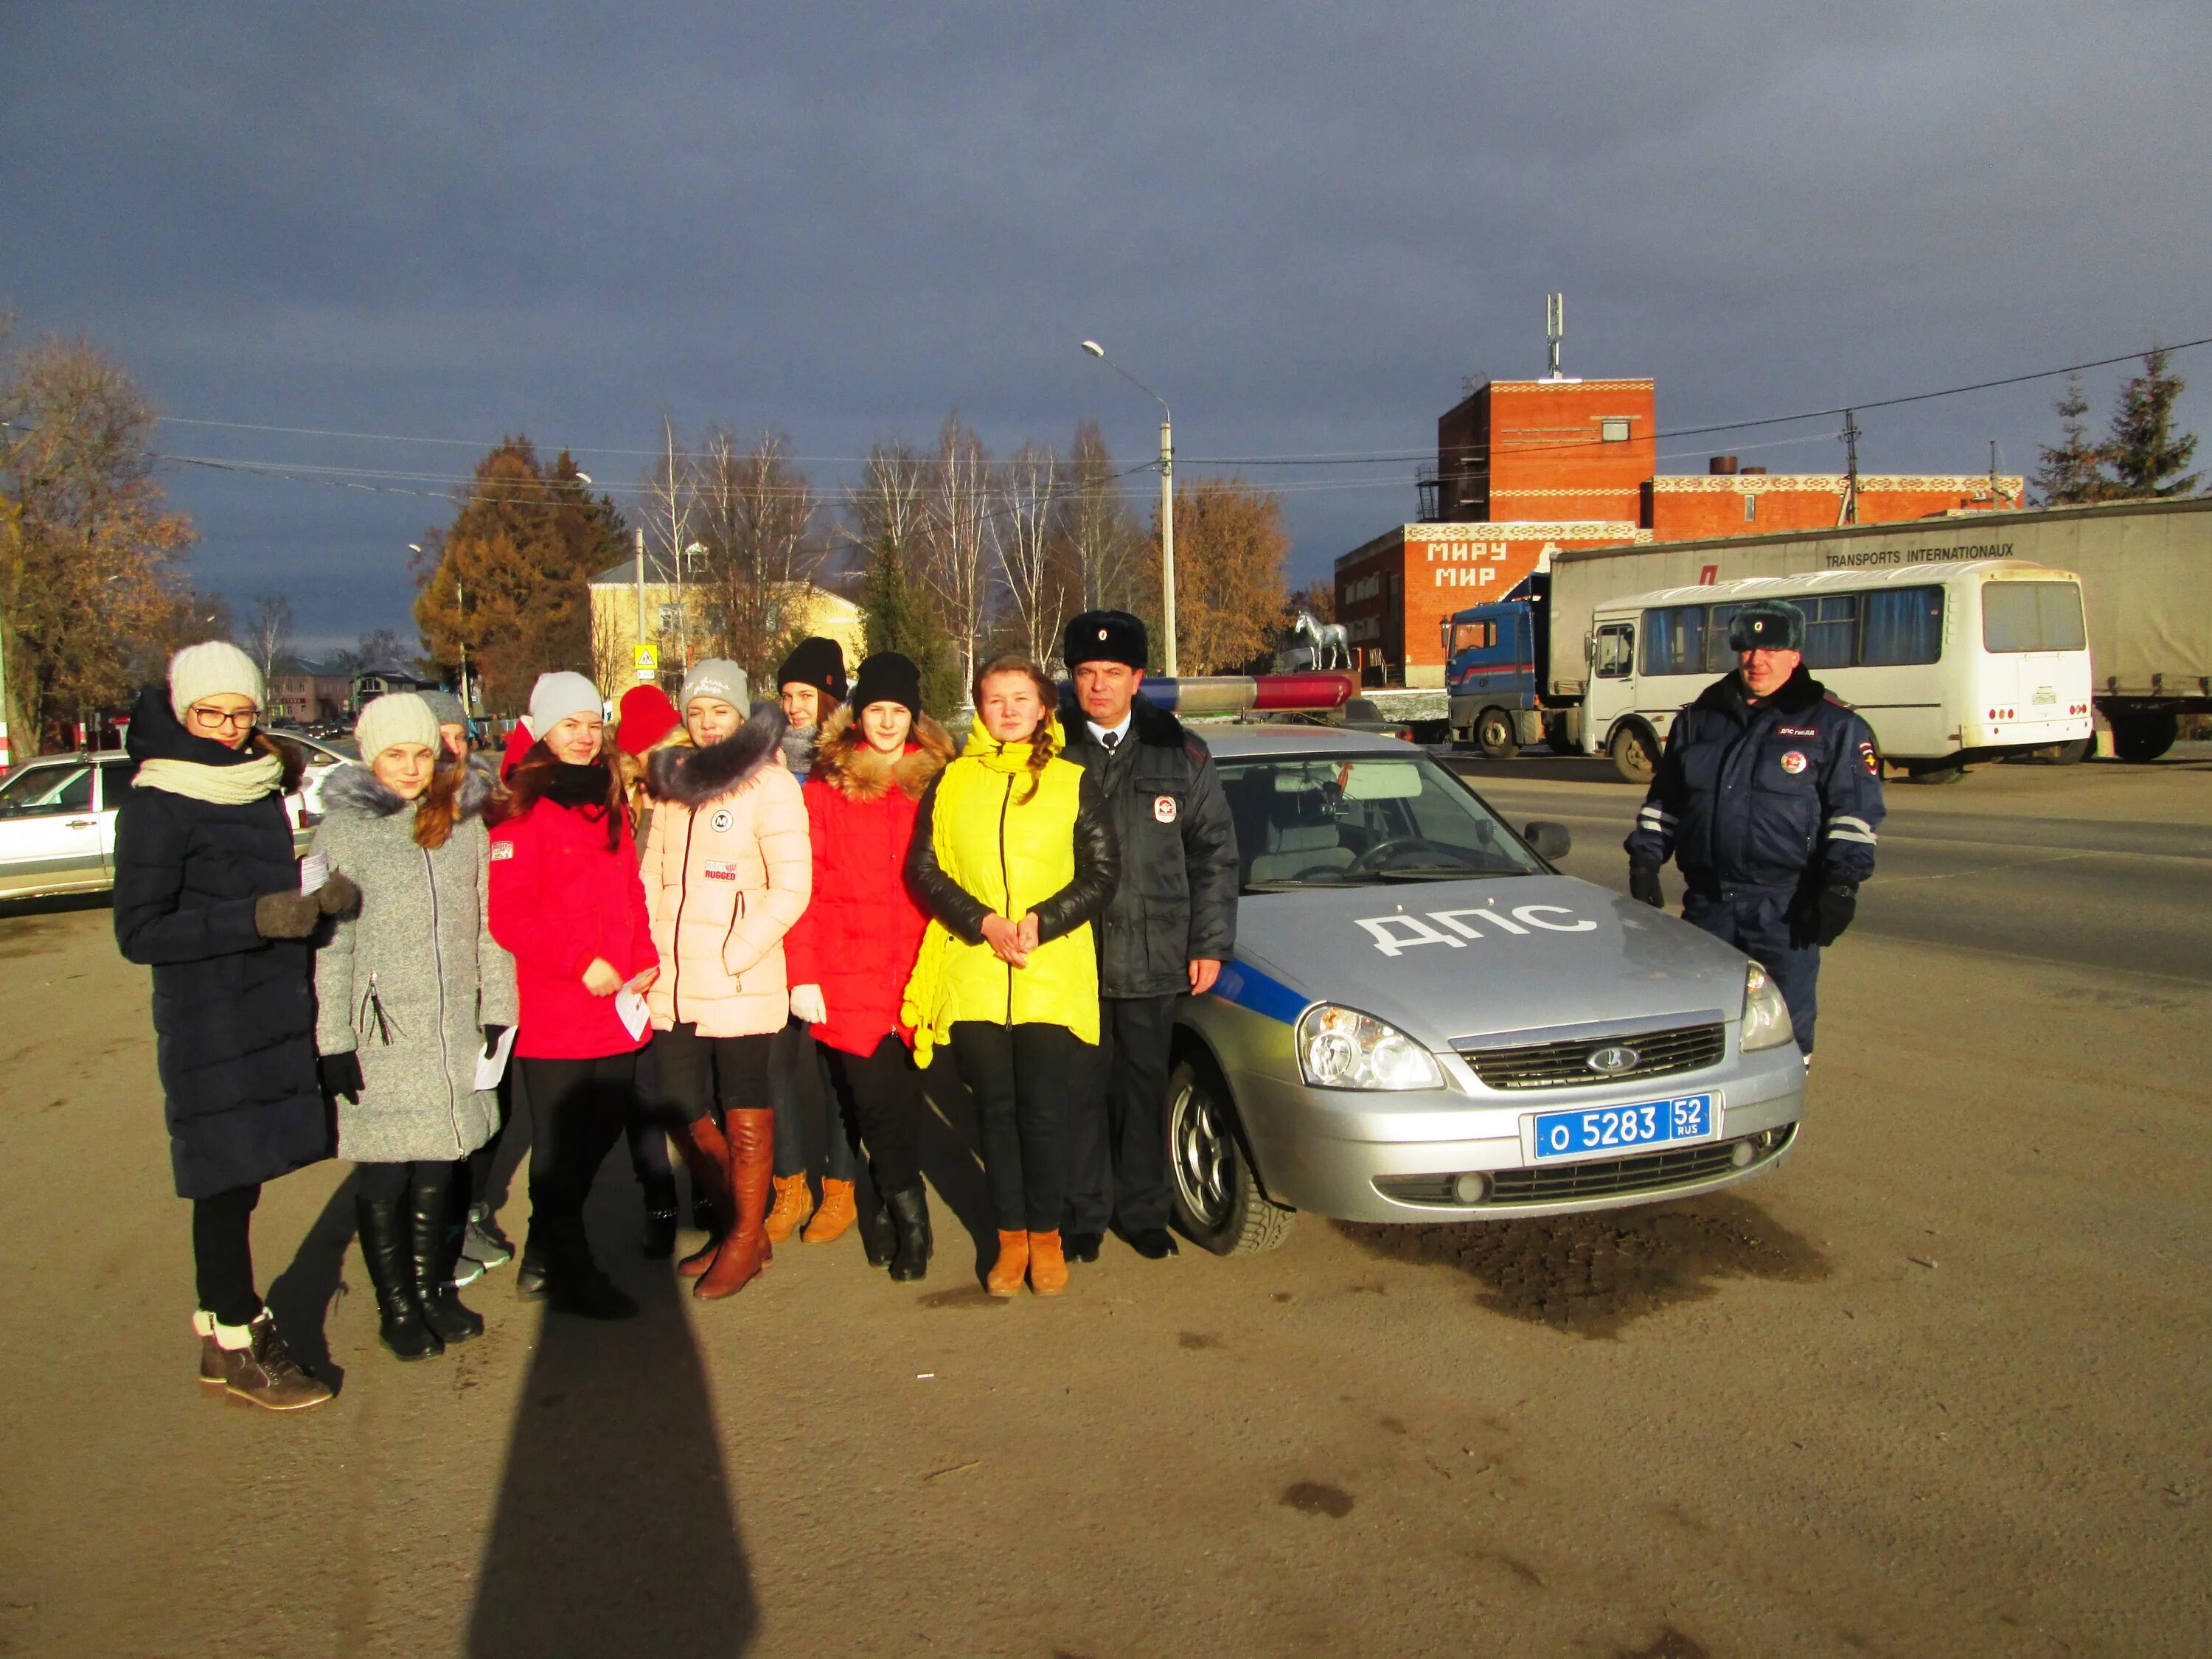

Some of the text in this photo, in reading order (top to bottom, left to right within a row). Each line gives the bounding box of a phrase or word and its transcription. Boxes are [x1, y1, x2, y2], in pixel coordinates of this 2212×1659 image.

[1427, 543, 1506, 561] МИРУ
[1826, 543, 2014, 568] TRANSPORTS INTERNATIONAUX
[1436, 568, 1495, 587] МИР
[716, 816, 727, 826] M
[705, 869, 736, 881] RUGGED
[1354, 905, 1597, 957] ДПС
[1582, 1106, 1656, 1147] 5283
[1674, 1099, 1701, 1125] 52
[1677, 1124, 1698, 1136] RUS
